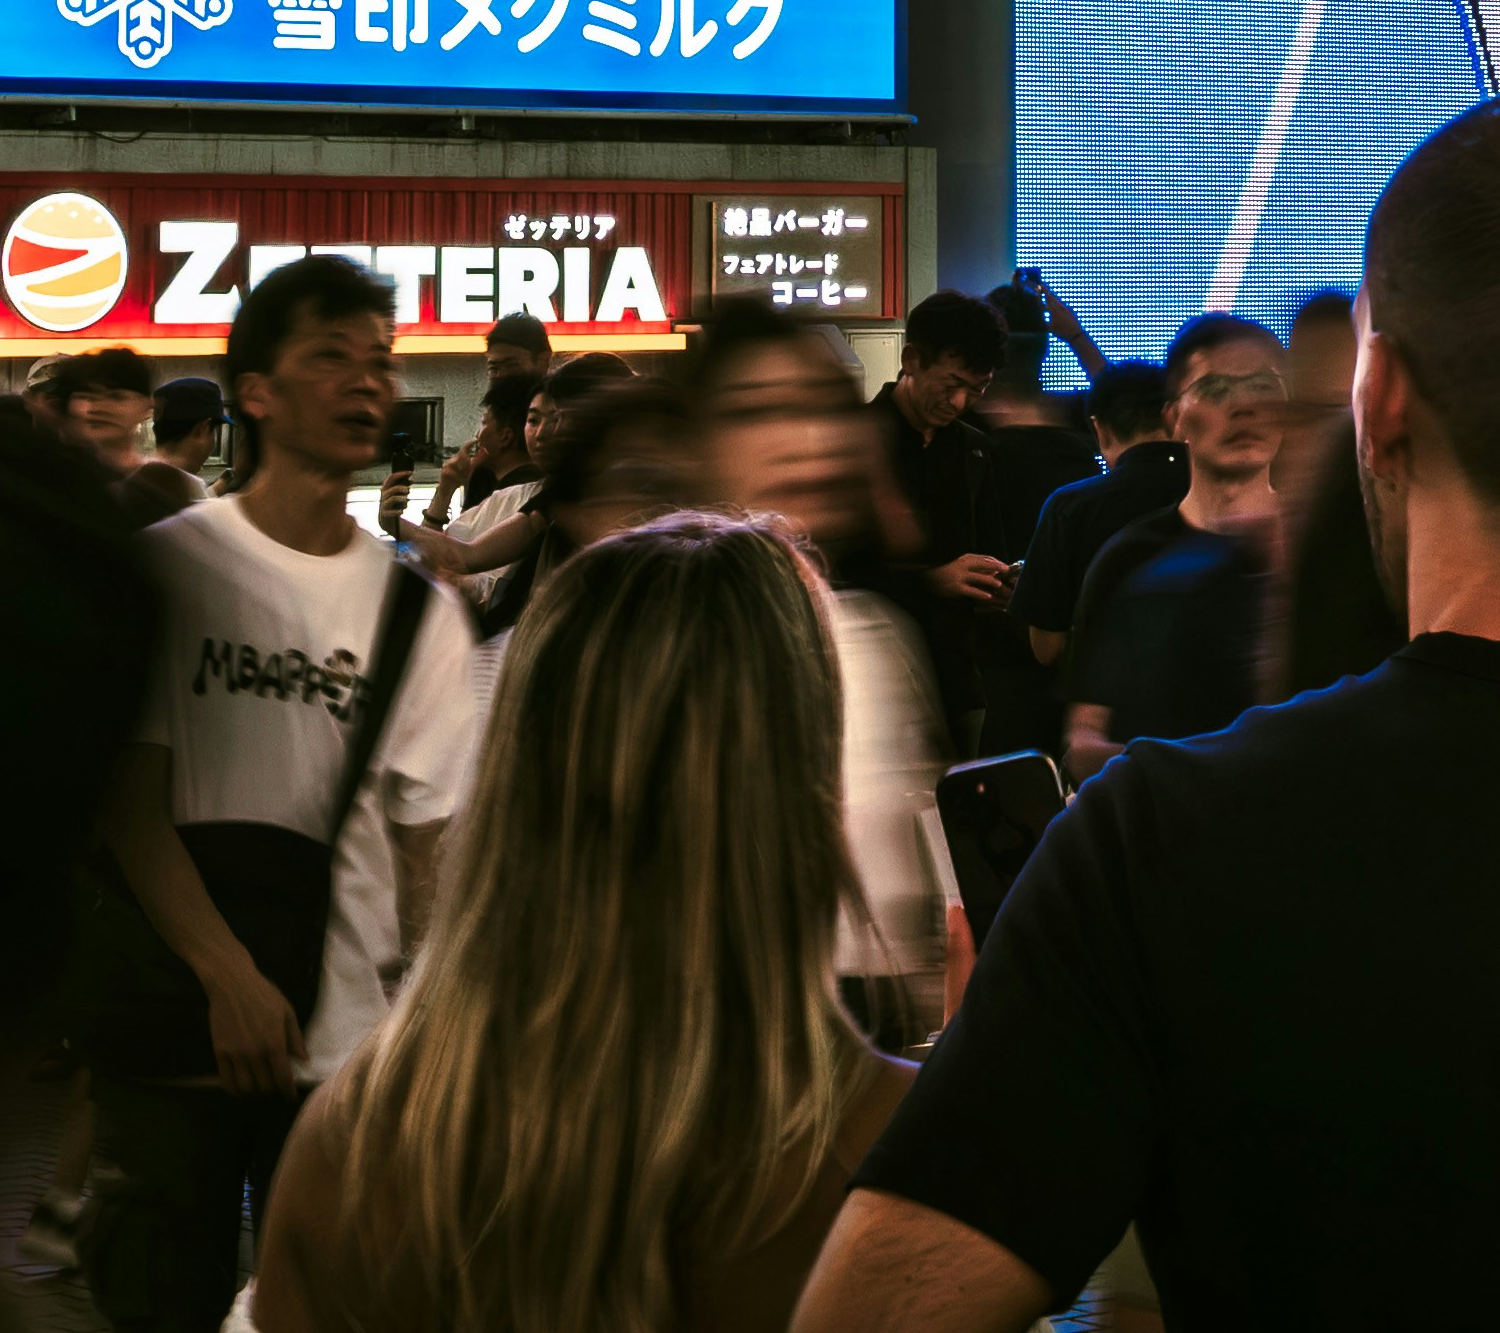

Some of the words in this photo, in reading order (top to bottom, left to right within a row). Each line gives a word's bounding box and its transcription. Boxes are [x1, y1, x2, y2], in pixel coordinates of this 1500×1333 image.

[503, 213, 617, 243] ゼッテリア
[153, 219, 668, 325] ZTERIA
[722, 252, 840, 276] フェアトレード
[771, 279, 869, 306] コーヒー
